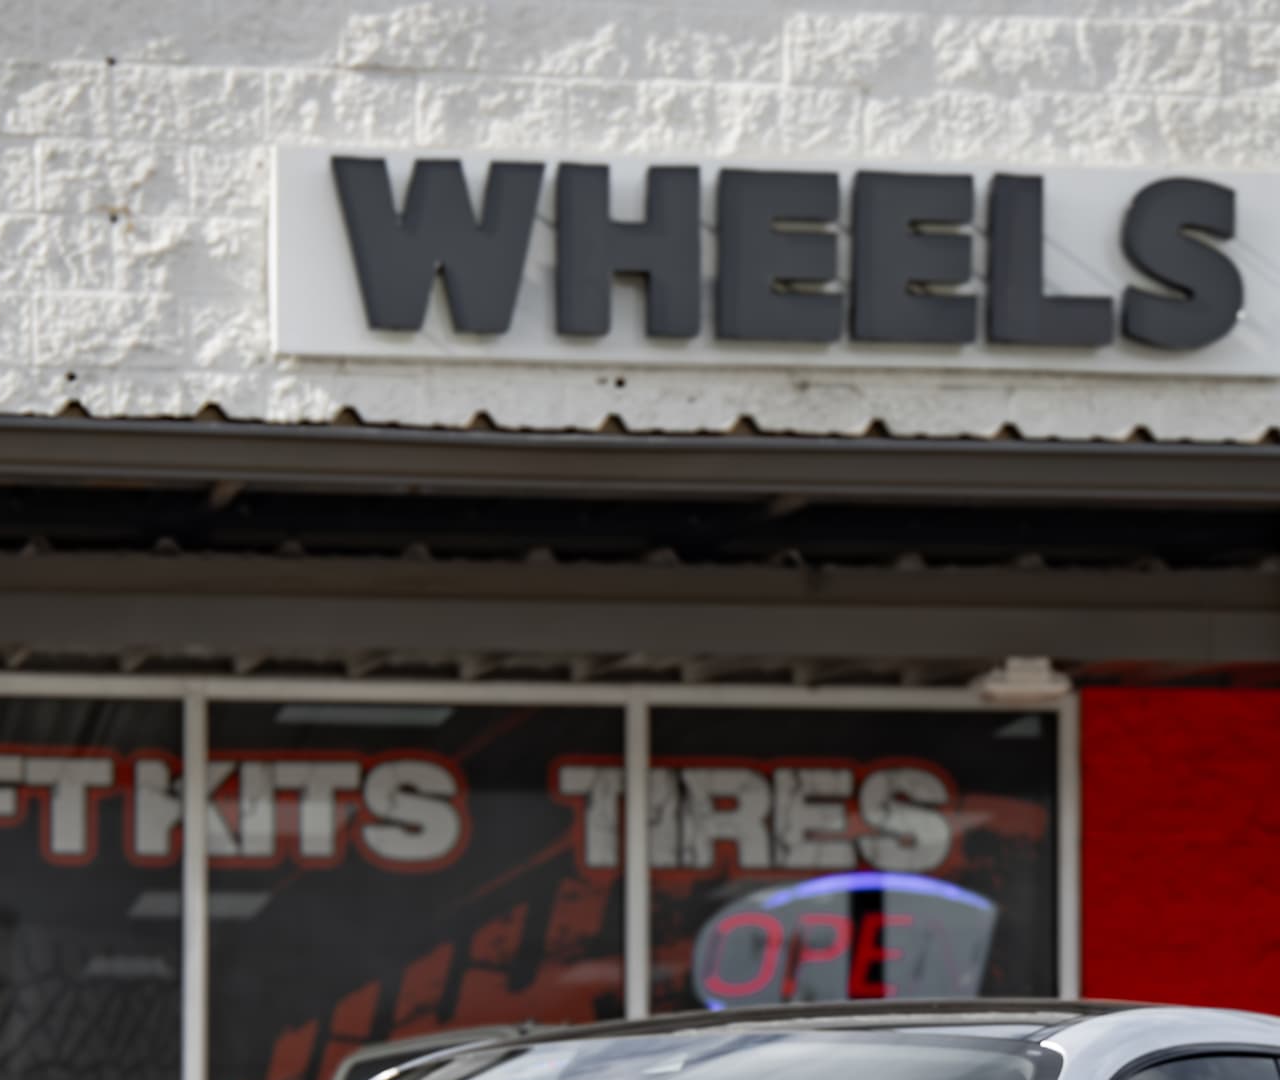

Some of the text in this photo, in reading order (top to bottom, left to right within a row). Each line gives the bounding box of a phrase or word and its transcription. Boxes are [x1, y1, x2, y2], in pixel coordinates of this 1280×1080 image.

[332, 156, 1245, 351] WHEELS
[133, 756, 462, 861] KITS
[558, 765, 953, 872] TIRES
[703, 911, 982, 999] OPE
